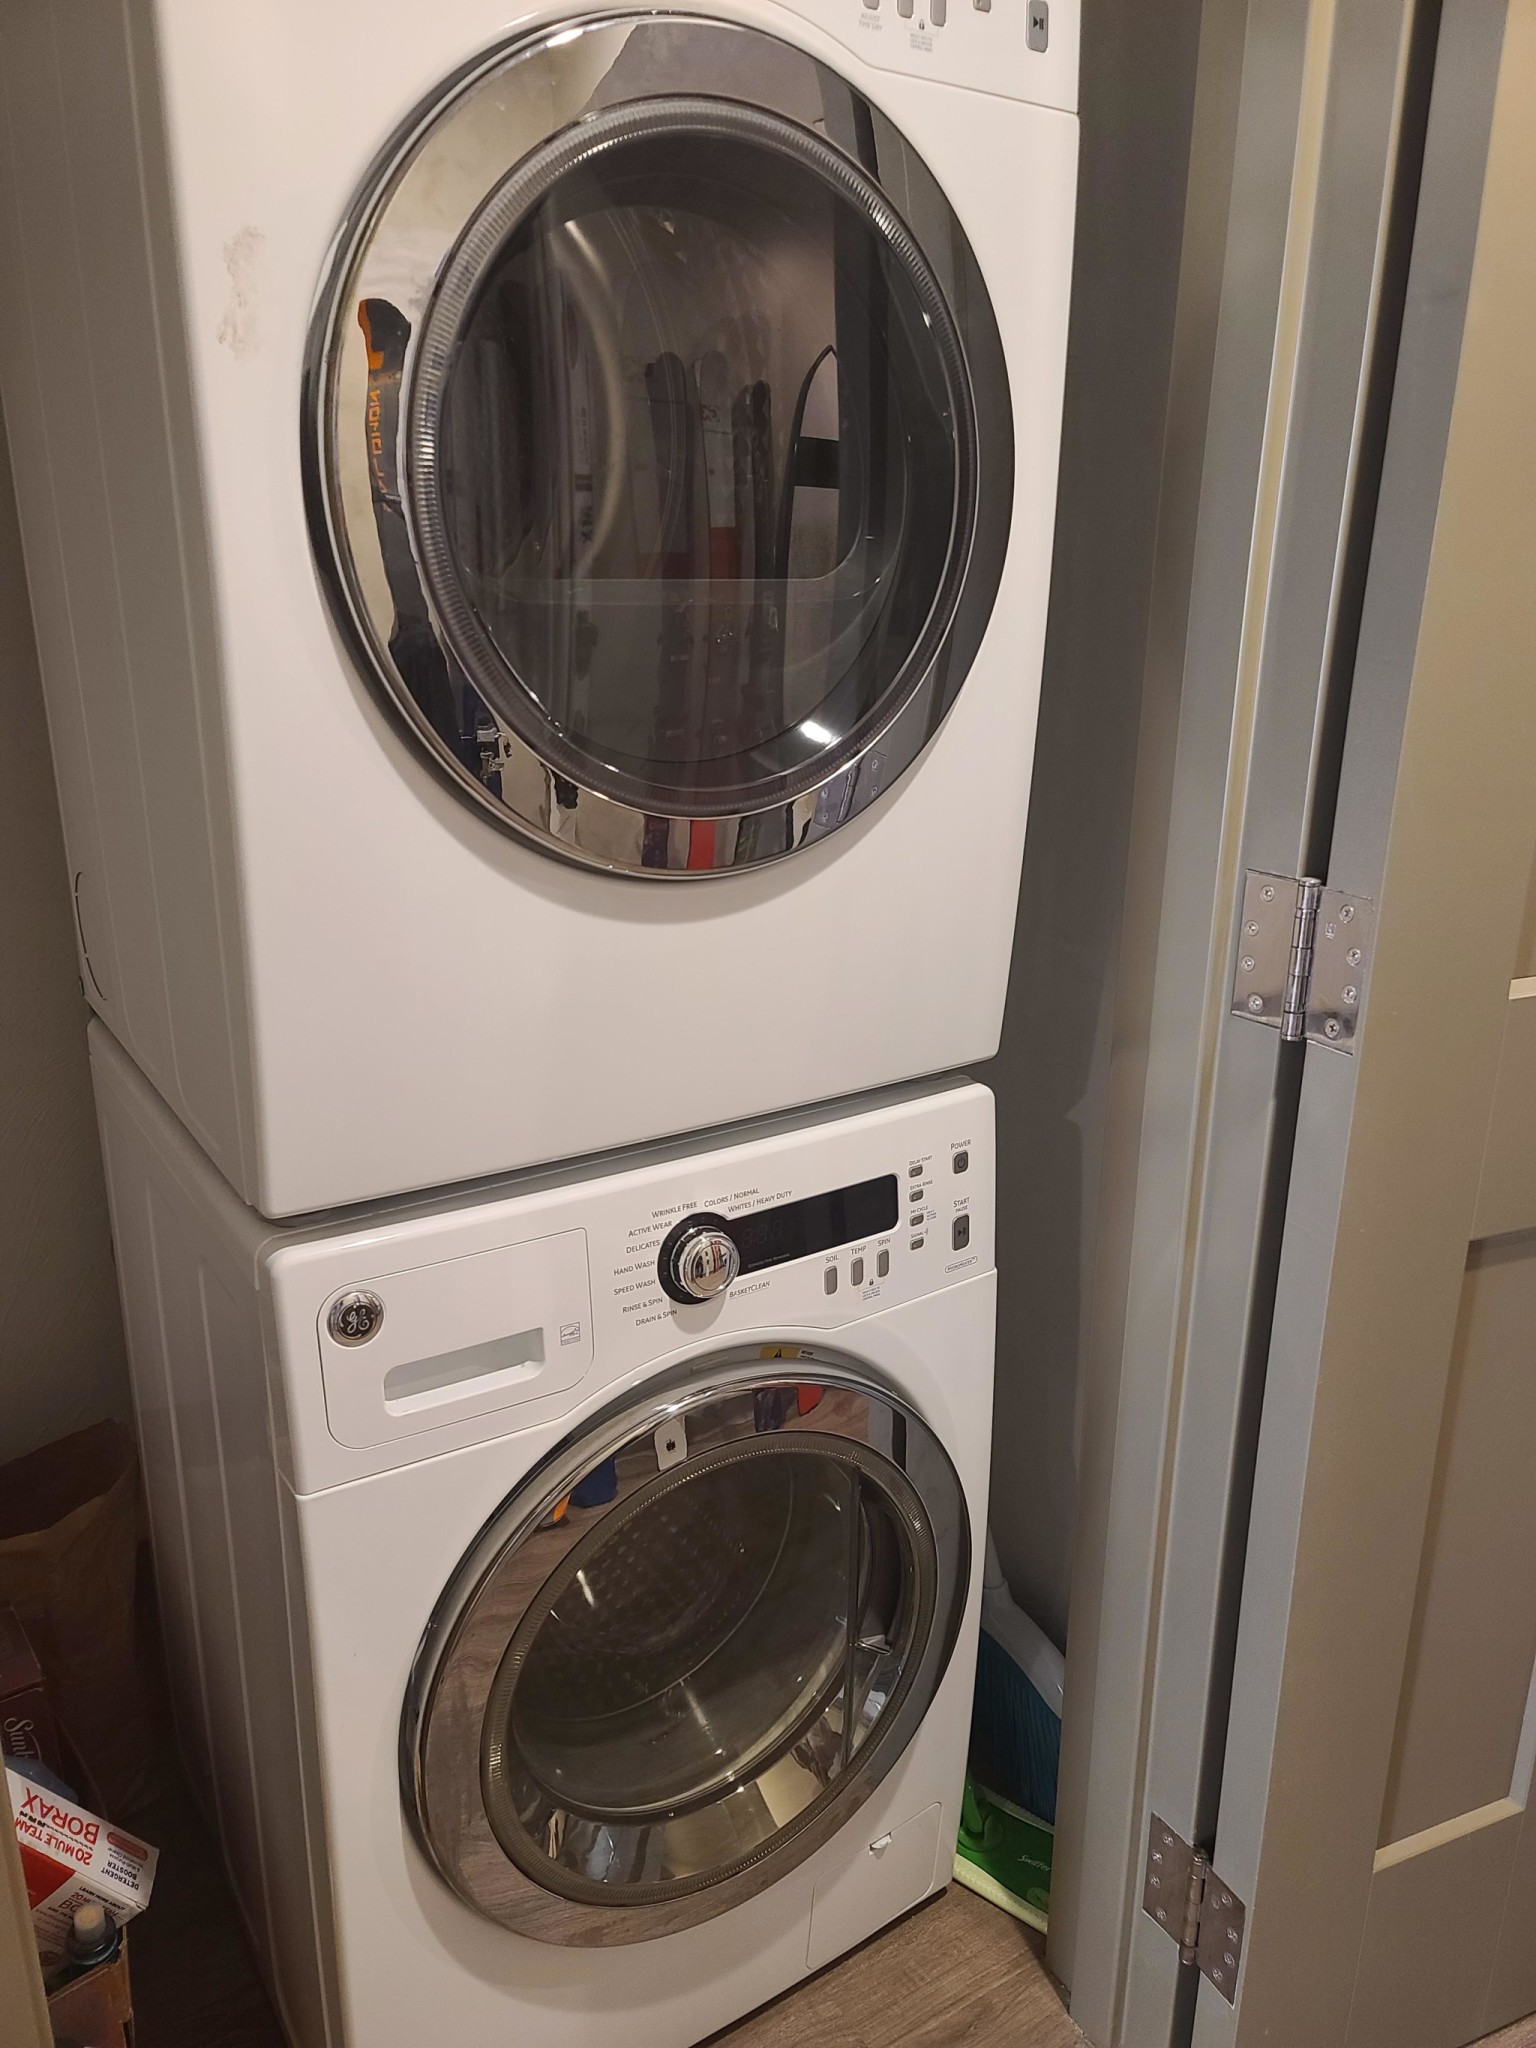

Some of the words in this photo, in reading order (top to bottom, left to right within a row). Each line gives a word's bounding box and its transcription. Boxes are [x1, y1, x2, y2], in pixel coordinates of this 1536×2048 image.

[950, 1139, 971, 1151] POWER
[704, 1197, 729, 1208] COLORS
[733, 1188, 760, 1200] NORMAL
[728, 1202, 752, 1214] WHITES
[756, 1195, 776, 1207] HEAVY
[776, 1190, 792, 1201] DUTY
[953, 1197, 970, 1208] START
[652, 1206, 682, 1219] WRINKLE
[682, 1201, 698, 1211] FREE
[628, 1225, 652, 1238] ACTIVE
[652, 1220, 673, 1231] WEAR
[626, 1239, 661, 1254] DELICATES
[851, 1245, 867, 1256] TEMP
[877, 1238, 891, 1247] SPIN
[825, 1254, 839, 1264] SOIL
[613, 1265, 634, 1276] HAND
[634, 1260, 656, 1271] WASH
[613, 1284, 635, 1296] SPEED
[635, 1279, 656, 1290] WASH
[622, 1303, 642, 1314] RINSE
[648, 1297, 664, 1307] SPIN
[635, 1315, 657, 1327] DRAIN
[662, 1309, 678, 1319] SPIN
[20, 1787, 100, 1845] BORAX
[14, 1817, 45, 1843] TEAM
[44, 1832, 76, 1860] MULE
[75, 1849, 93, 1865] 20
[101, 1866, 140, 1891] DETERGENT
[106, 1860, 138, 1881] BOOSTER
[79, 1886, 95, 1897] LEARN
